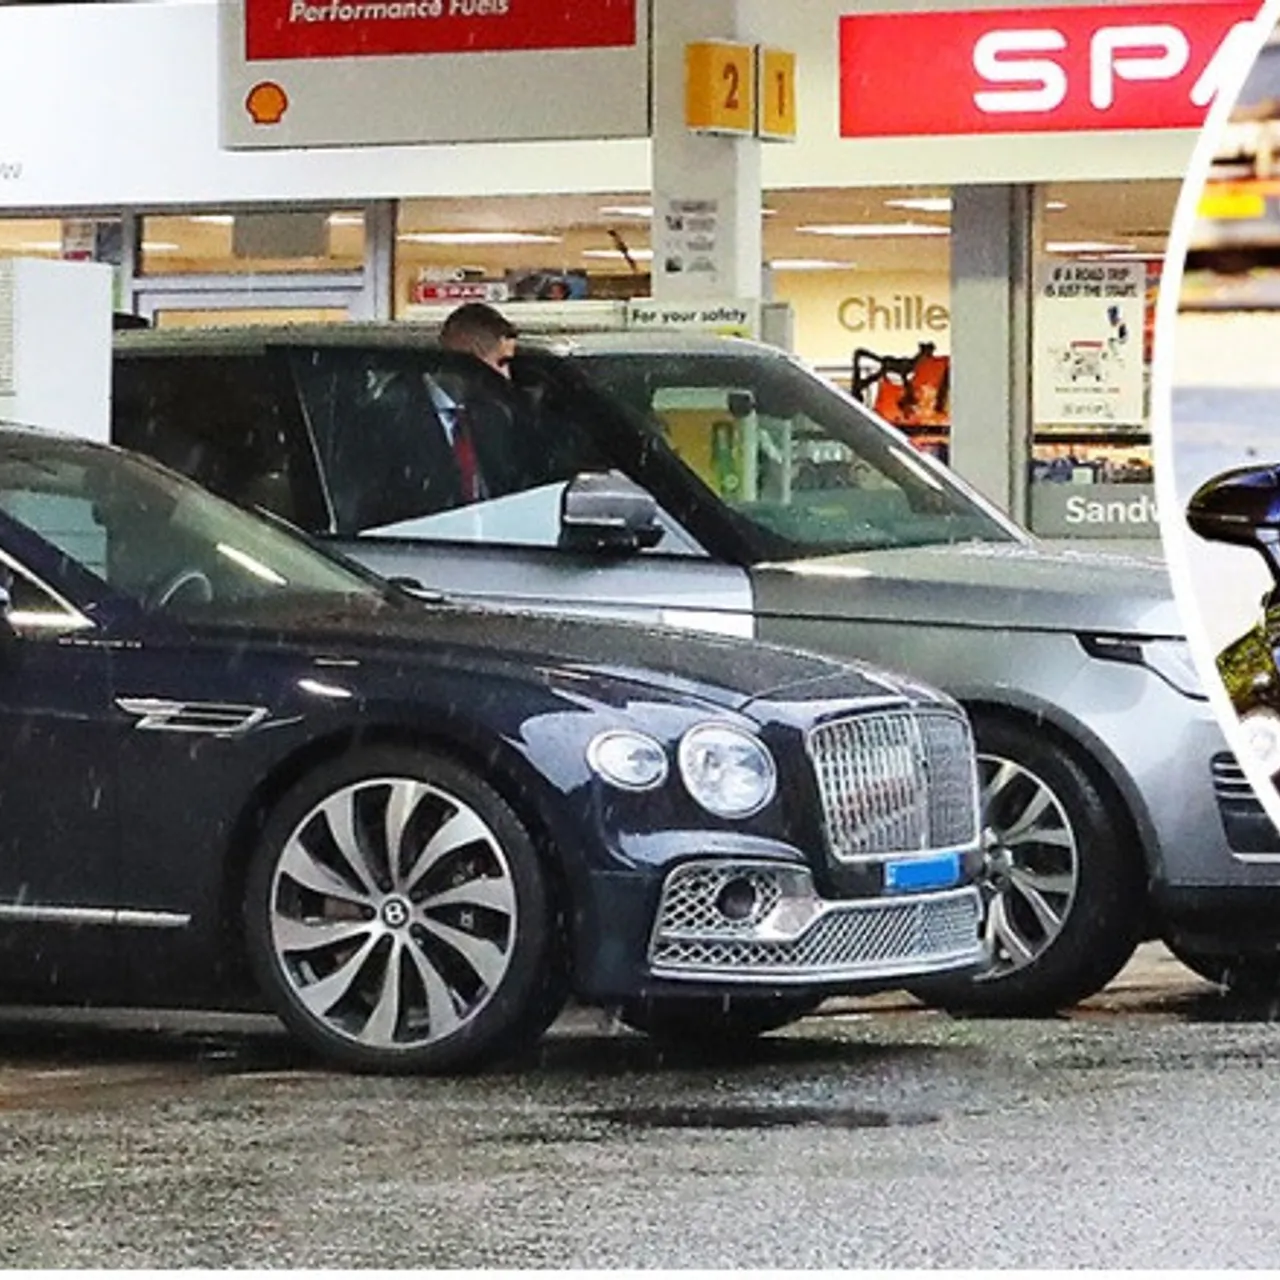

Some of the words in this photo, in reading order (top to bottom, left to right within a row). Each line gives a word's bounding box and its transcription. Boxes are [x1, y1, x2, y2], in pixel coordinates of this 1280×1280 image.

[290, 0, 442, 22] Performance
[449, 0, 508, 16] Fuels
[723, 63, 739, 109] 2
[777, 71, 784, 116] 1
[633, 310, 656, 323] For
[664, 310, 695, 324] your
[702, 308, 747, 324] safety
[837, 297, 949, 332] Chille
